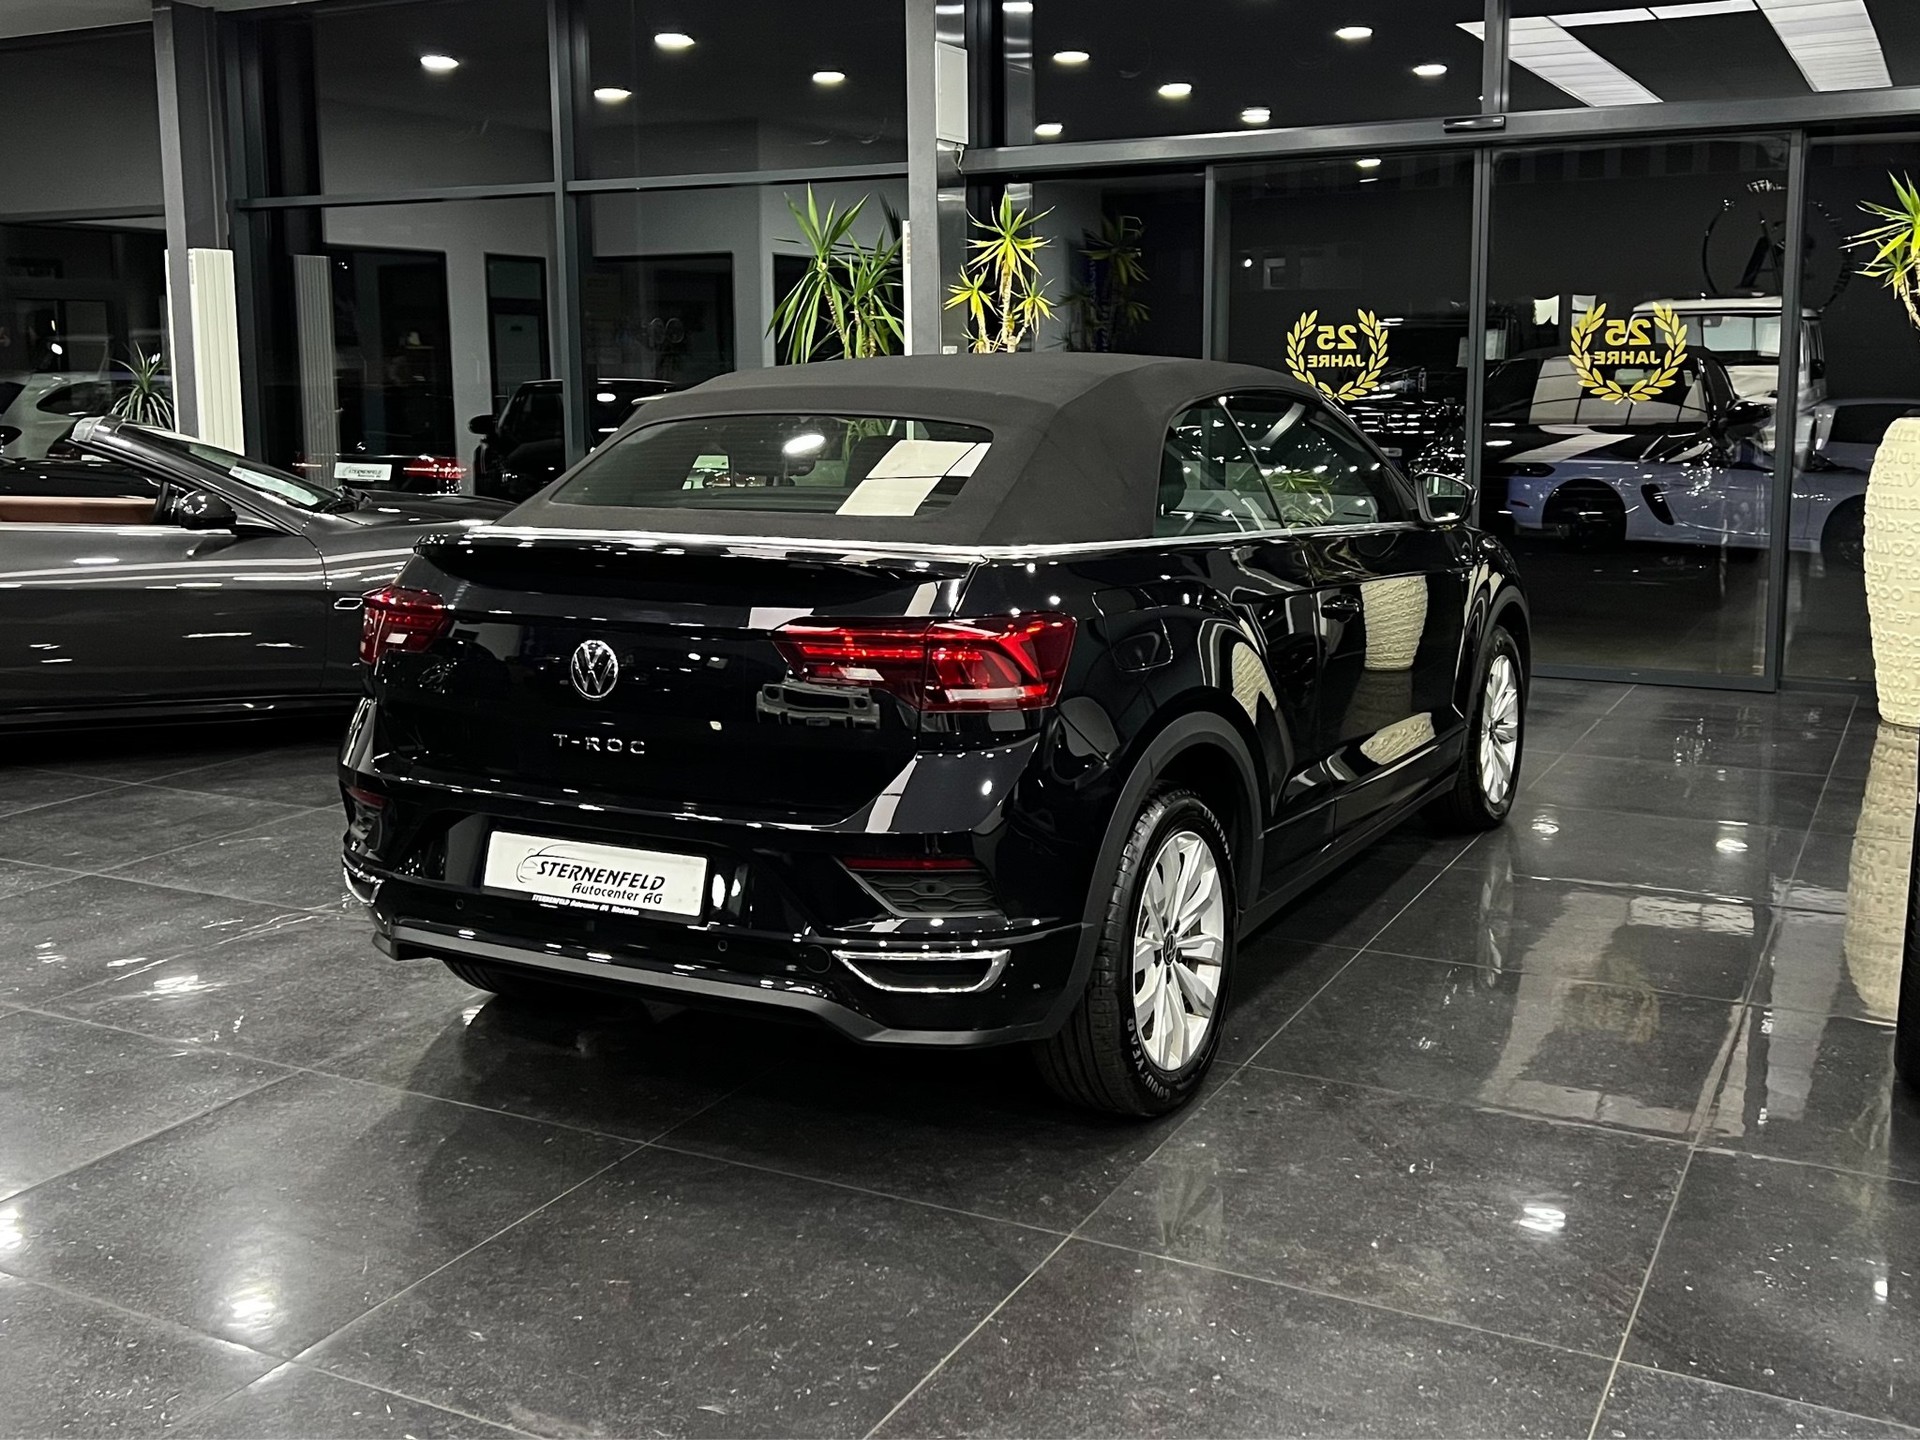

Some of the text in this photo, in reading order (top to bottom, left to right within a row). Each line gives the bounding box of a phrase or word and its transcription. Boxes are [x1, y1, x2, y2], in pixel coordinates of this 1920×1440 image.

[552, 733, 645, 754] T-ROC
[537, 860, 666, 891] STERNENFELD
[571, 882, 663, 905] Autocenter AG
